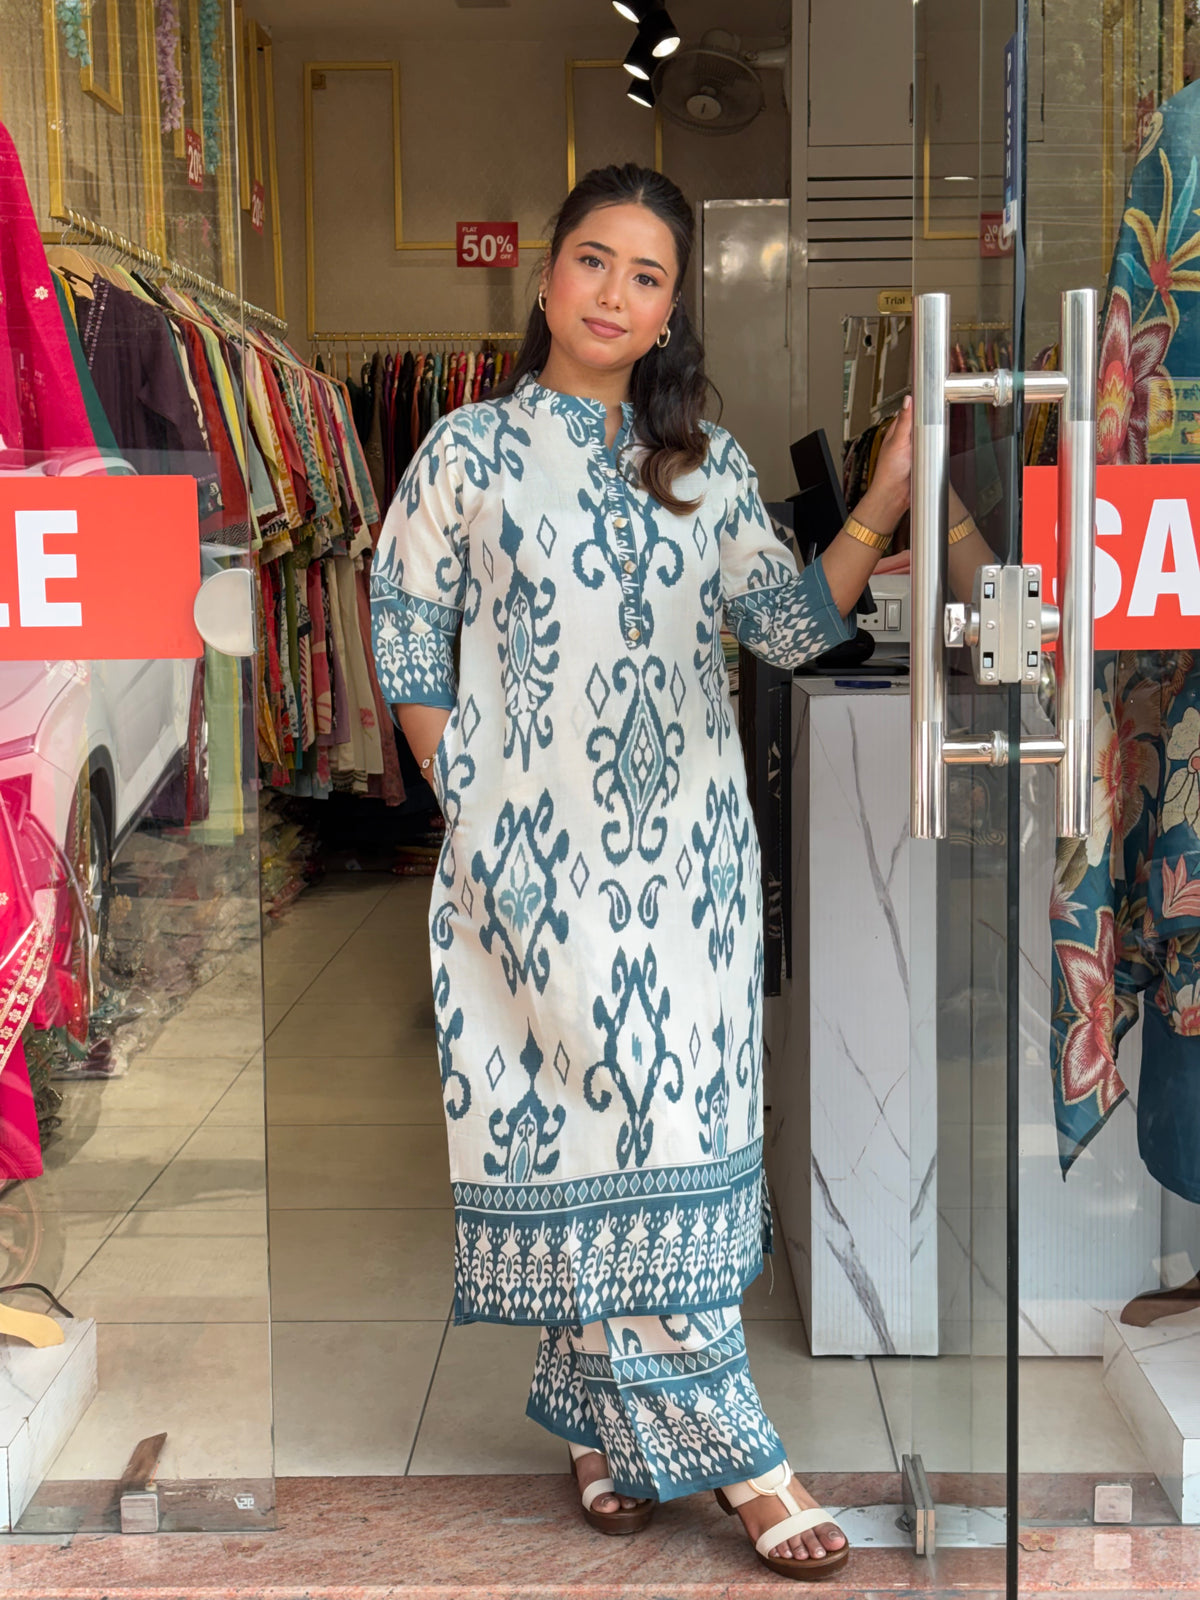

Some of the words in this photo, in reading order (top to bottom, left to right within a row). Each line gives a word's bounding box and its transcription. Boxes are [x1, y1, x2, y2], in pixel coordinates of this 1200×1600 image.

[462, 234, 514, 262] 50%
[884, 296, 905, 304] Trial
[0, 510, 83, 628] E
